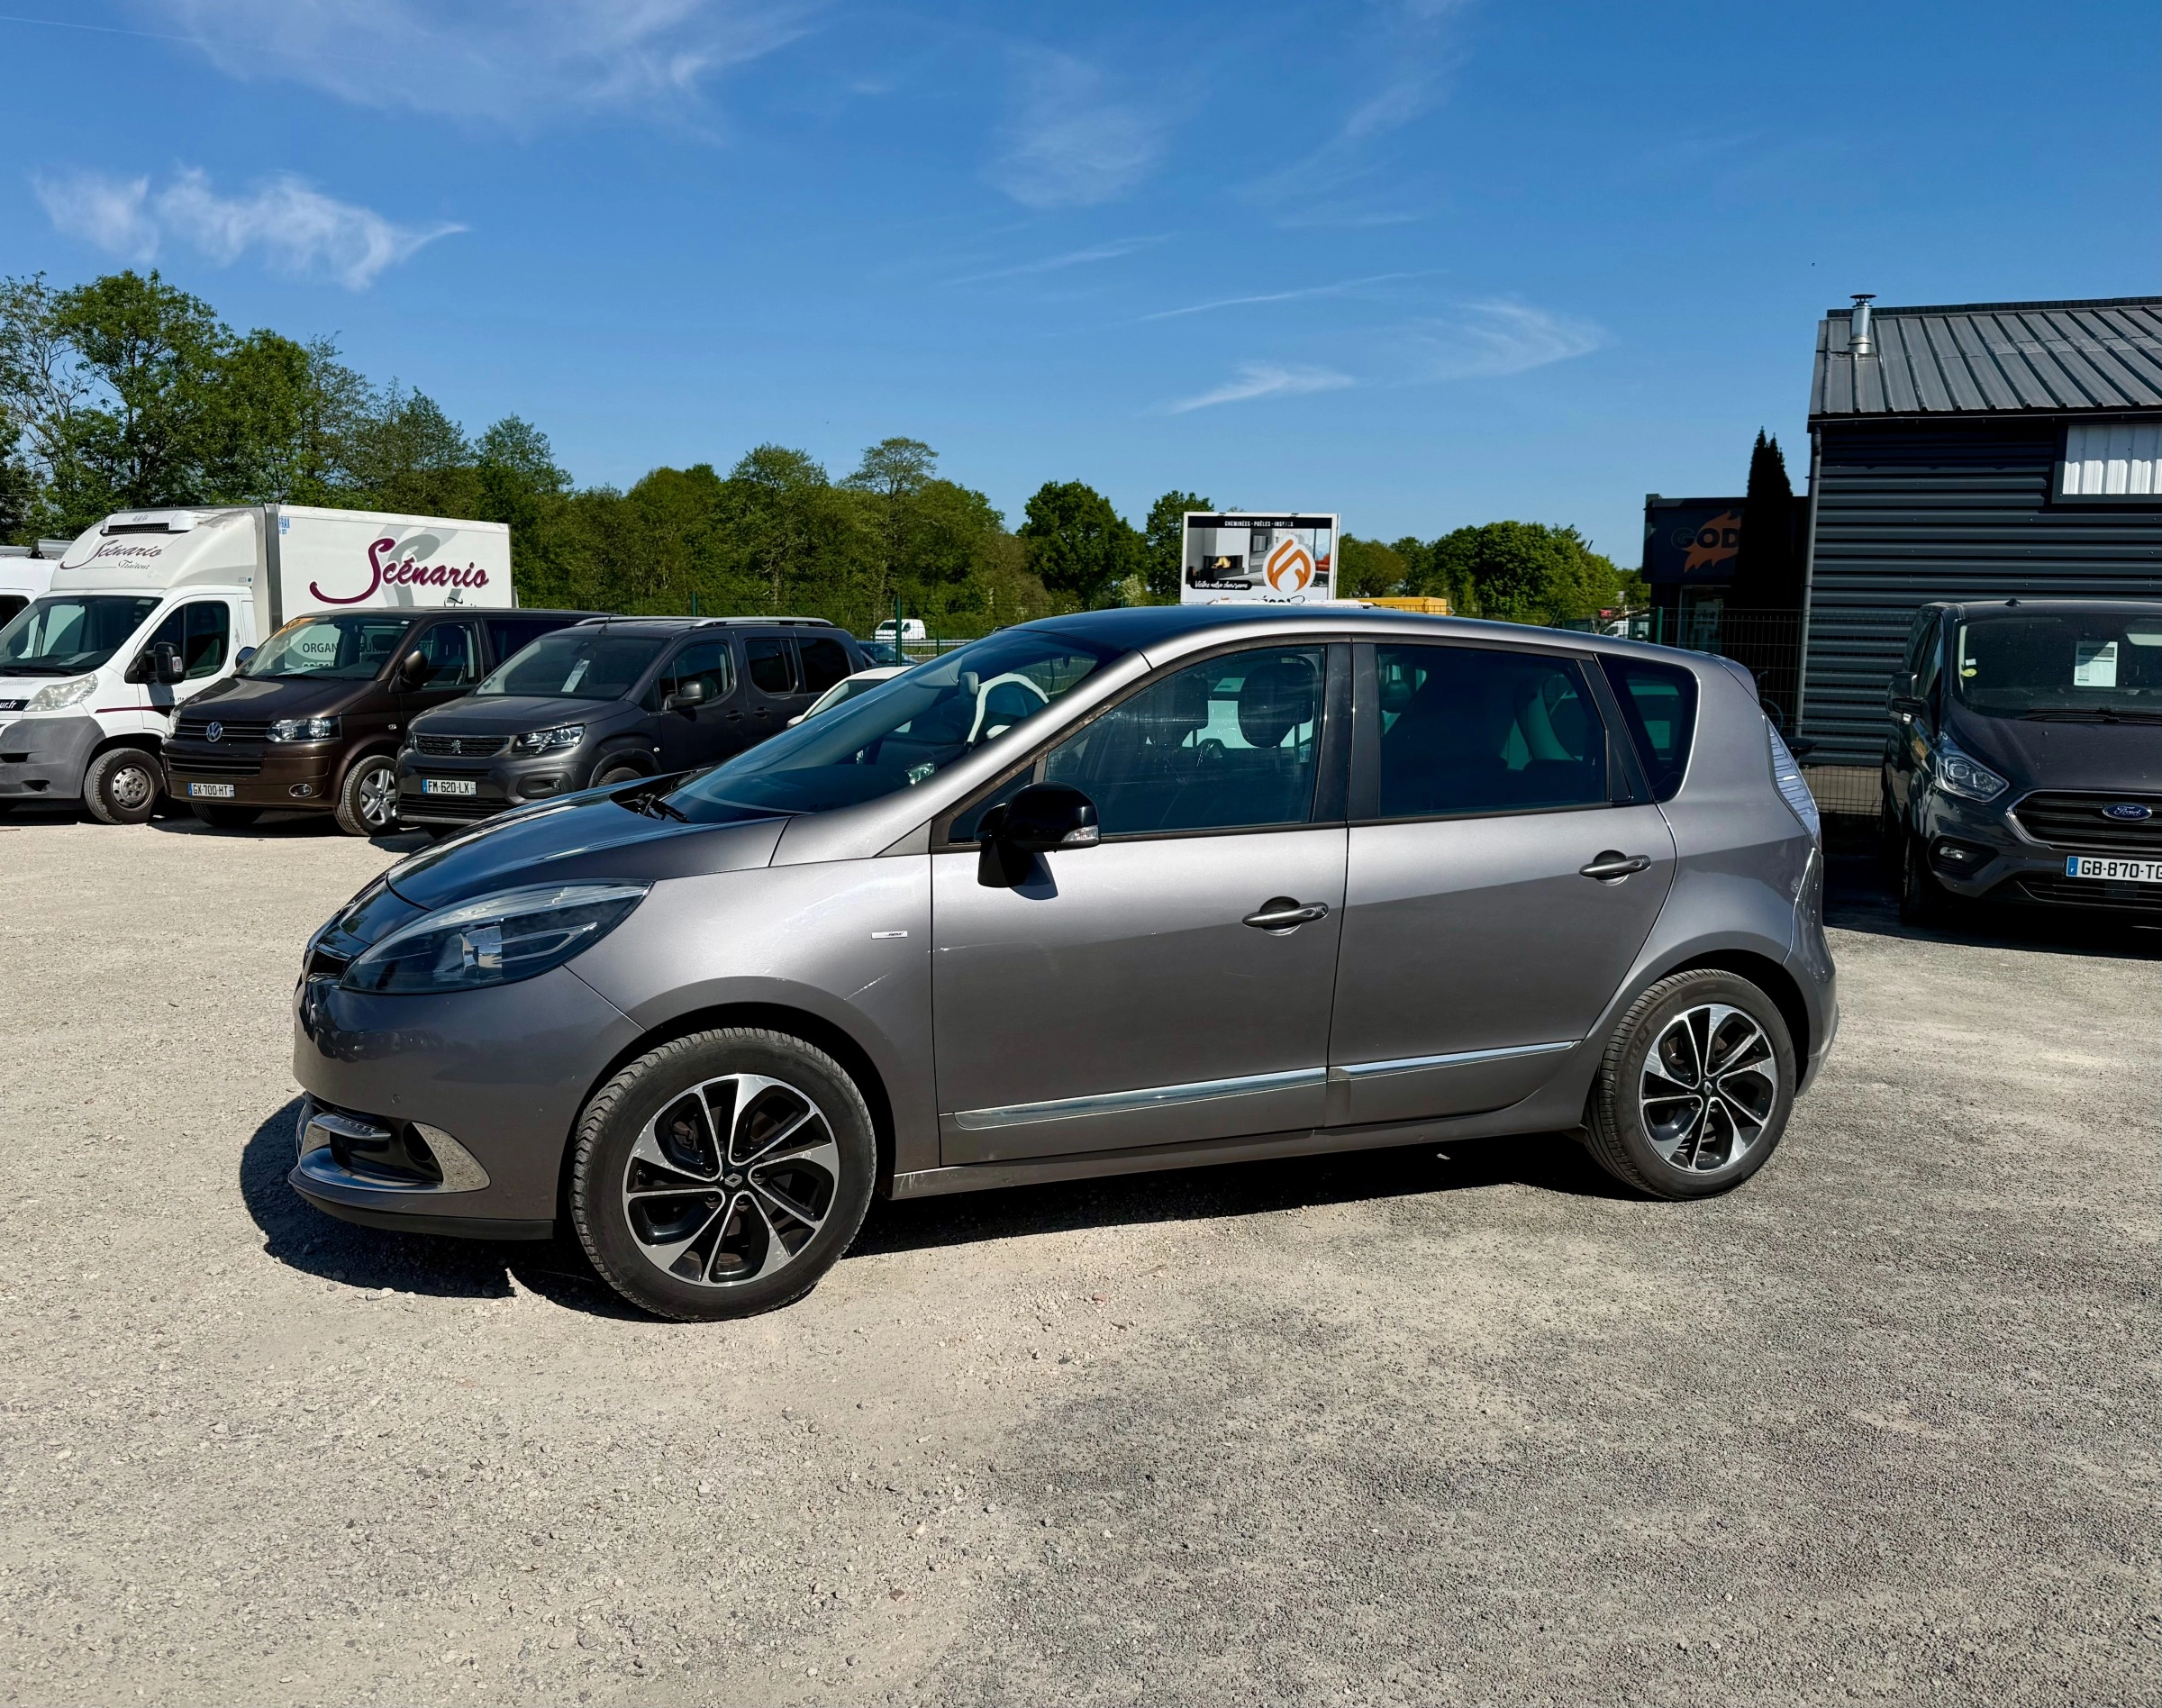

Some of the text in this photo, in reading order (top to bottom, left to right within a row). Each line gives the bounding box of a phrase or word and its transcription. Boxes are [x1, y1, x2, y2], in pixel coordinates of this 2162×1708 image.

[1671, 527, 1740, 549] GOD
[59, 540, 162, 569] Scénario
[309, 538, 490, 604] Scénario
[193, 785, 228, 795] GX-700-HT
[428, 781, 469, 793] FM-620-LX
[2113, 805, 2141, 817] Ford
